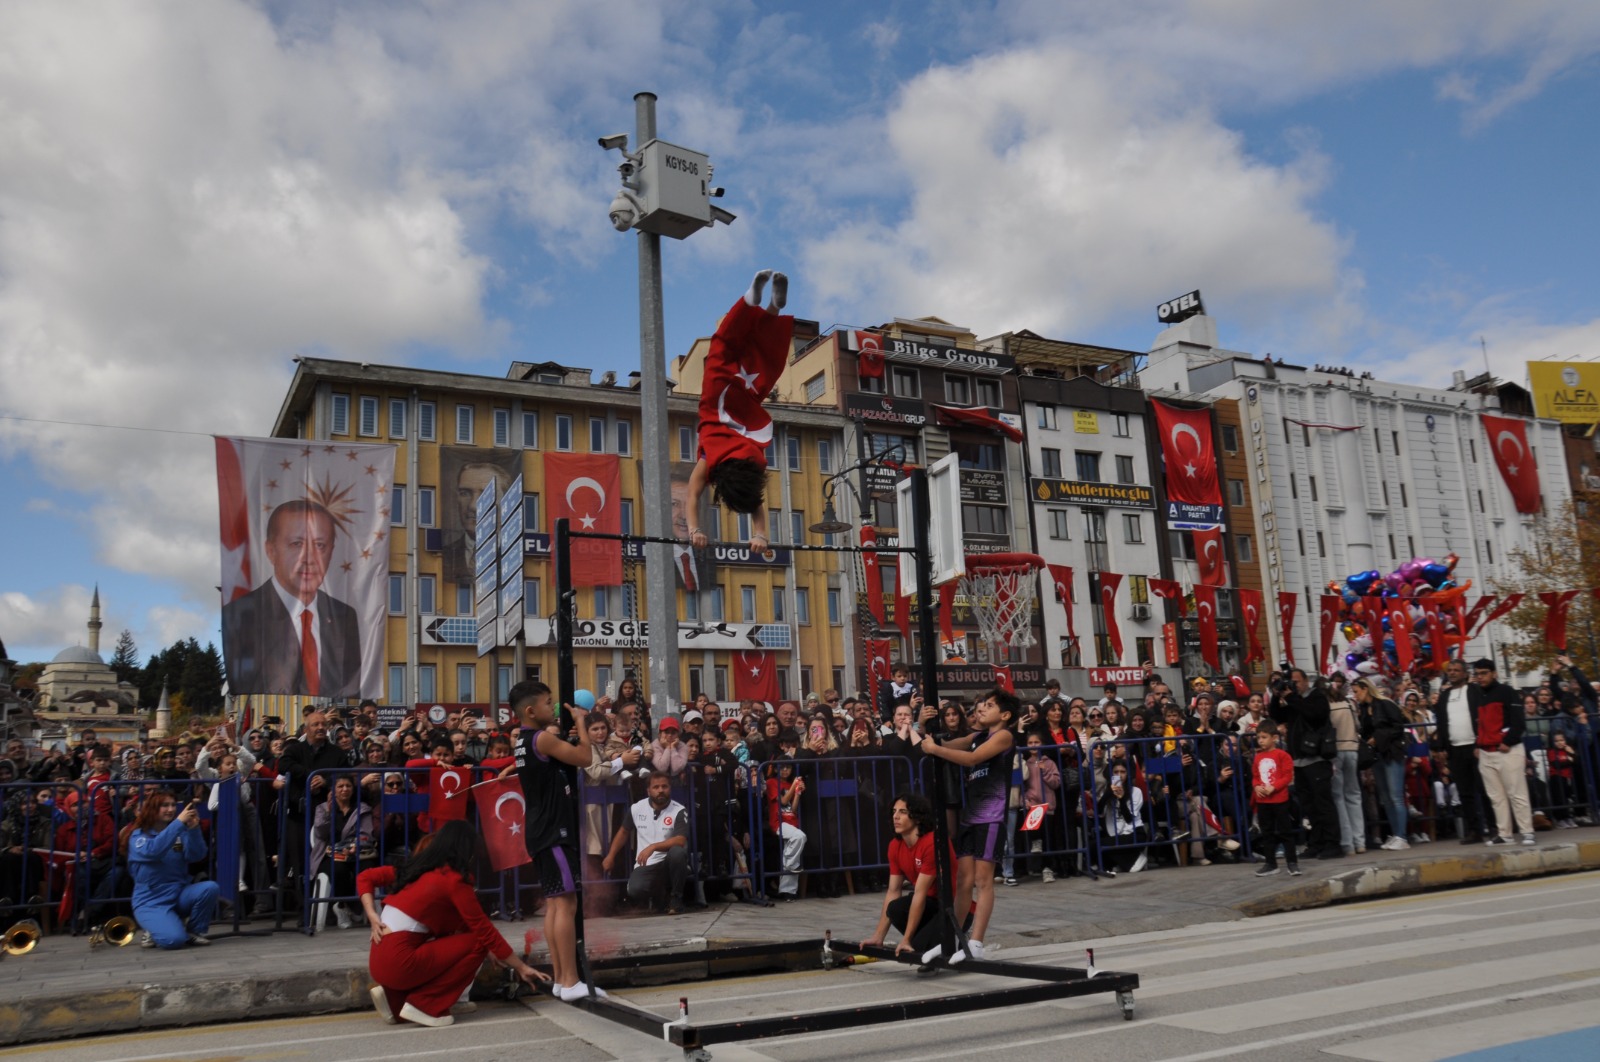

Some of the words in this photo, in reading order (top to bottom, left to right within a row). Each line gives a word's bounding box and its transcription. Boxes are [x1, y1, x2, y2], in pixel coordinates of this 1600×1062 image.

[665, 154, 699, 176] KGYS-06
[1158, 292, 1199, 319] OTEL
[893, 340, 938, 359] Bilge
[945, 349, 999, 368] Group
[1181, 504, 1211, 513] ANAHTAR
[947, 669, 996, 682] SÜRÜCÜ
[1091, 672, 1103, 682] 1.
